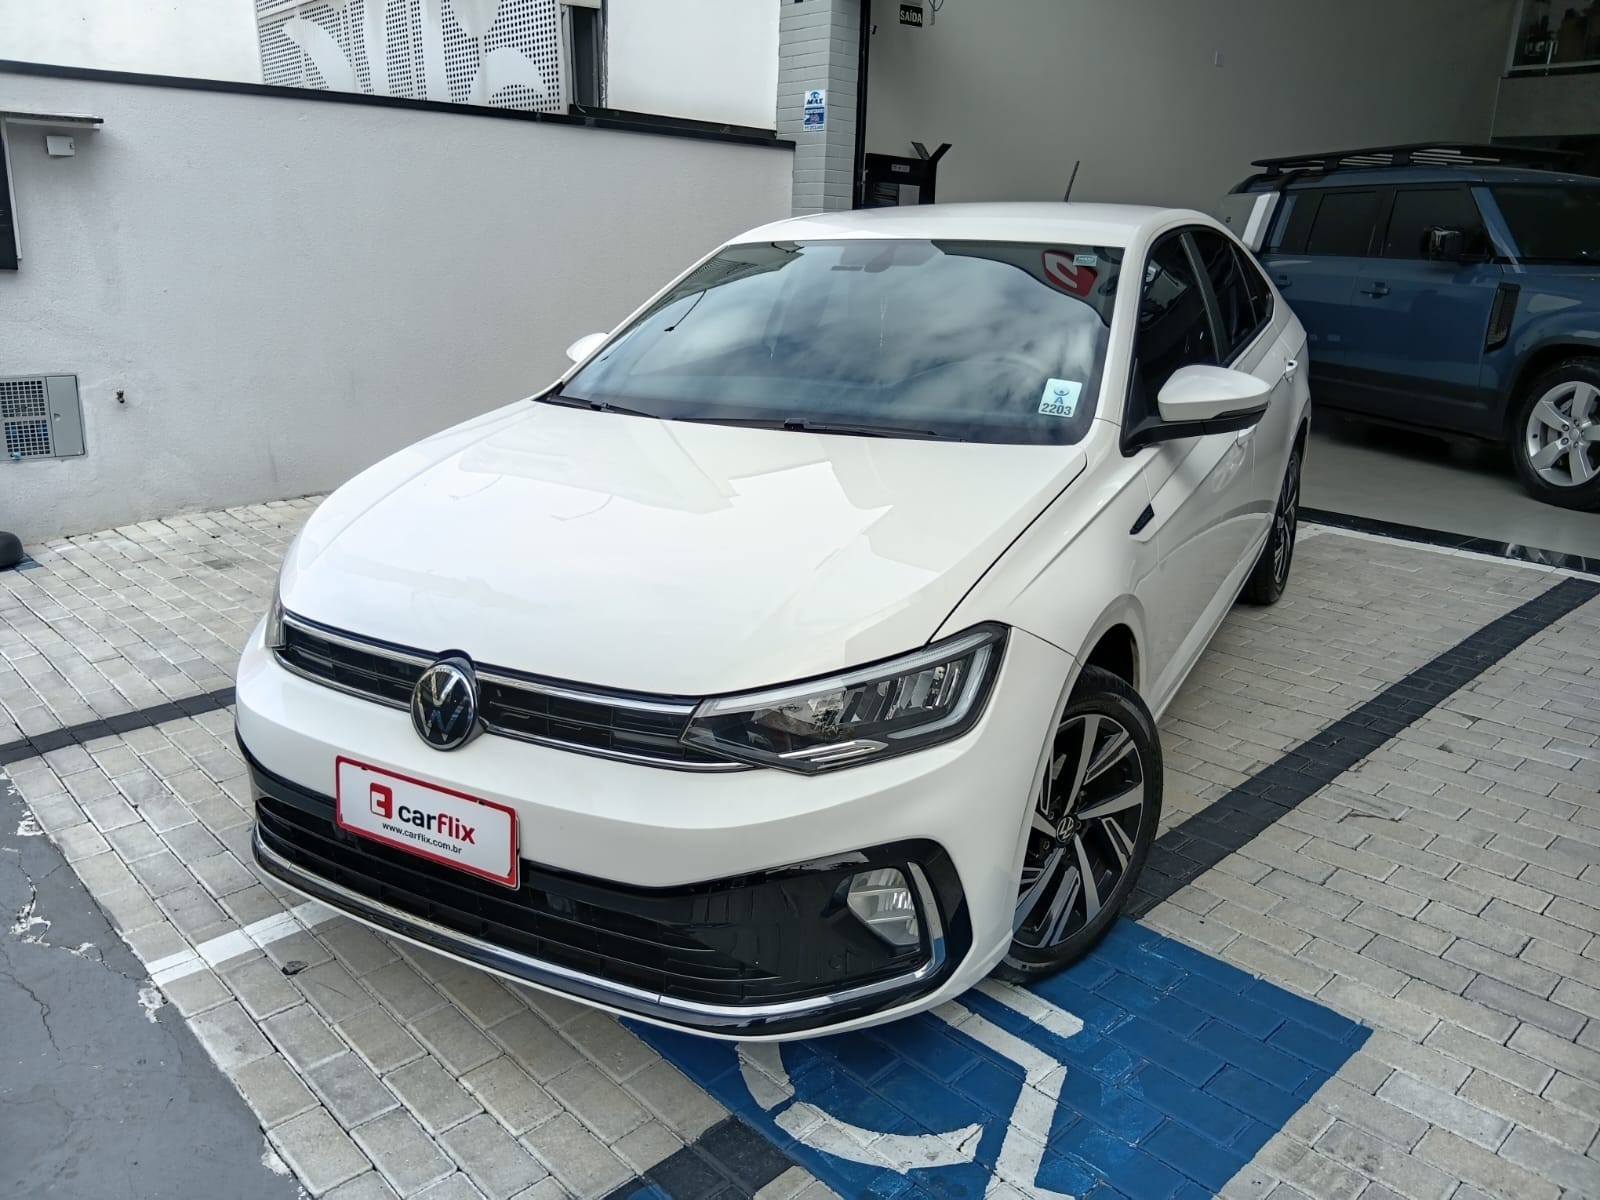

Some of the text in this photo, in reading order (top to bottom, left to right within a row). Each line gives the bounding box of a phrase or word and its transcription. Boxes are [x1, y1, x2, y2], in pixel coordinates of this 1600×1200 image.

[900, 9, 922, 24] SAÍDA
[1041, 402, 1072, 416] 2203
[398, 804, 476, 845] carflix
[382, 821, 463, 855] www.carflix.com.br
